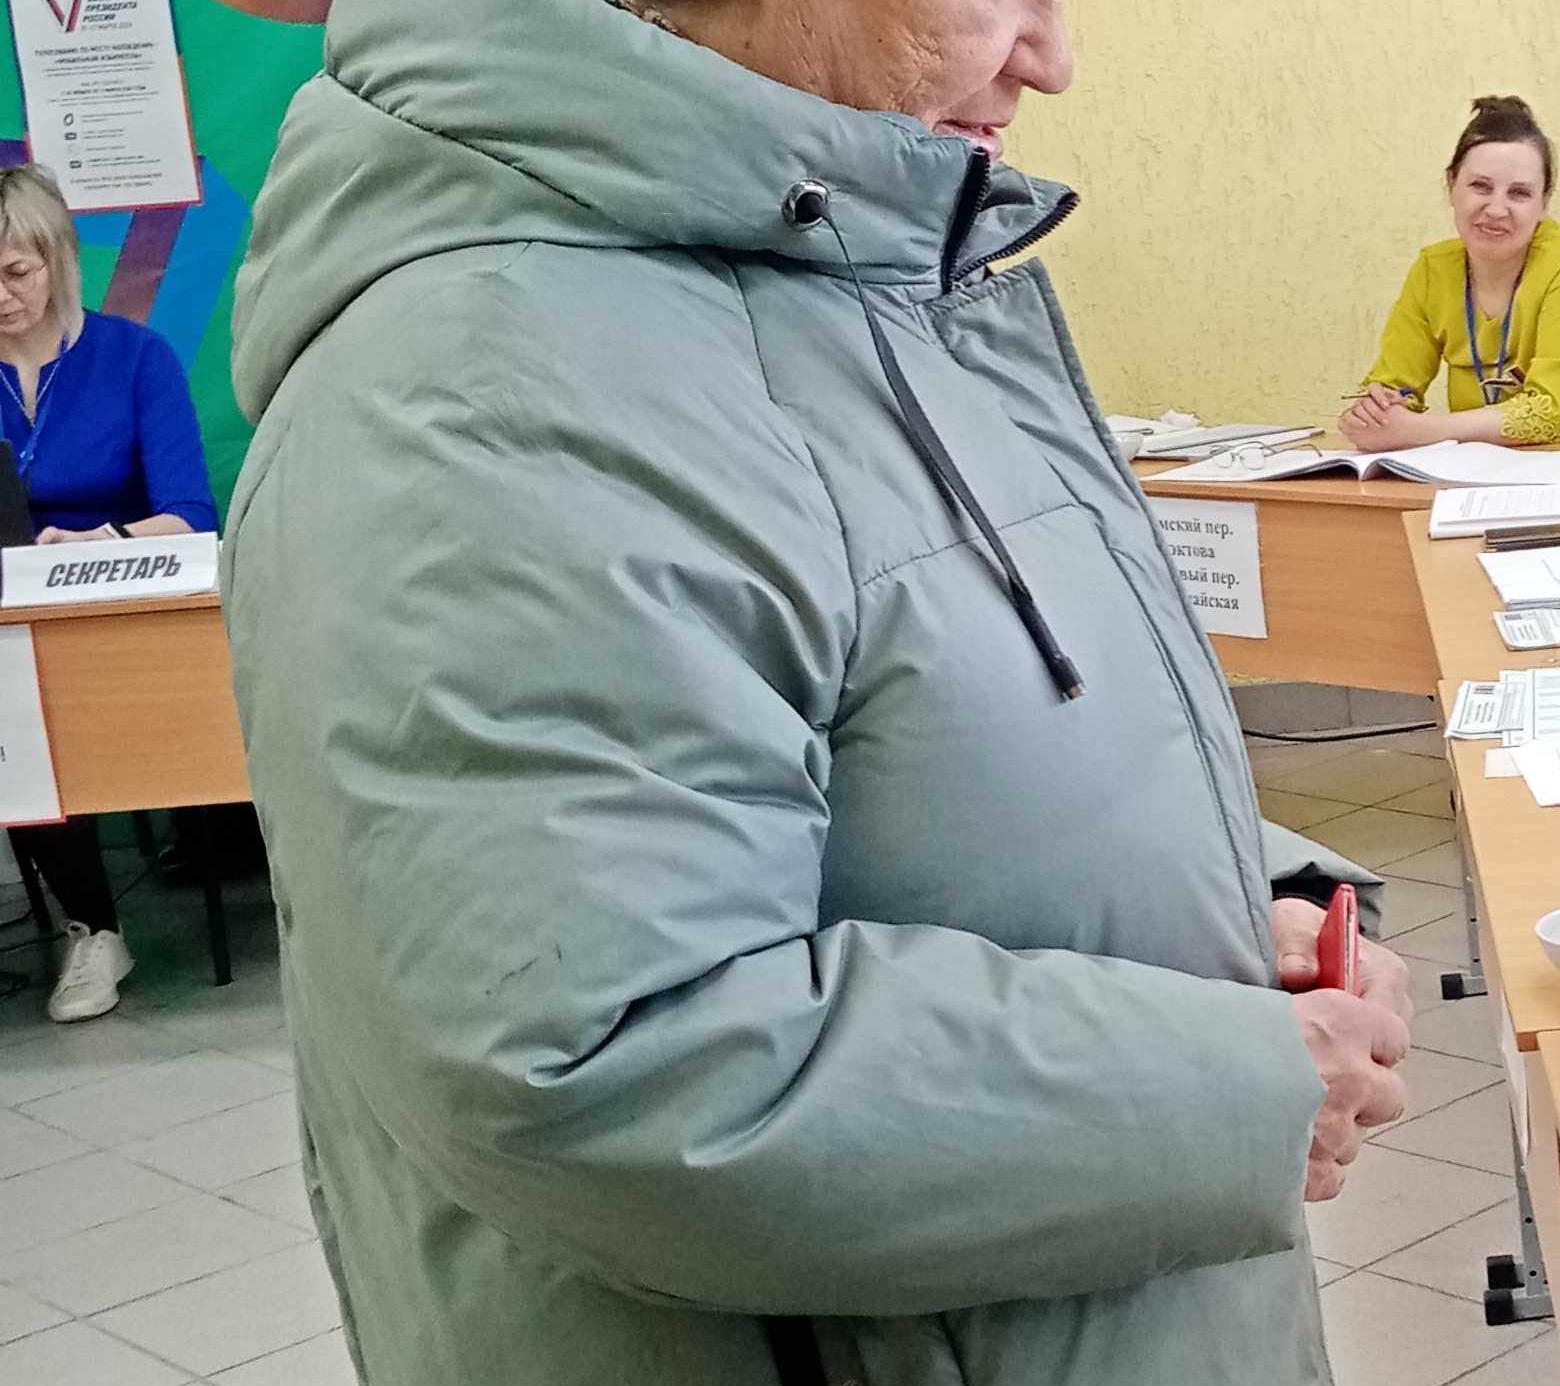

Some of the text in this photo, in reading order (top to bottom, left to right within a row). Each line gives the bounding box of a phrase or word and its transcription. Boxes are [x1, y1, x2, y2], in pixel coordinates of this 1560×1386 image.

[1205, 520, 1234, 540] пер.
[45, 552, 182, 588] СЕКРЕТАРЬ
[1211, 570, 1241, 589] пер.
